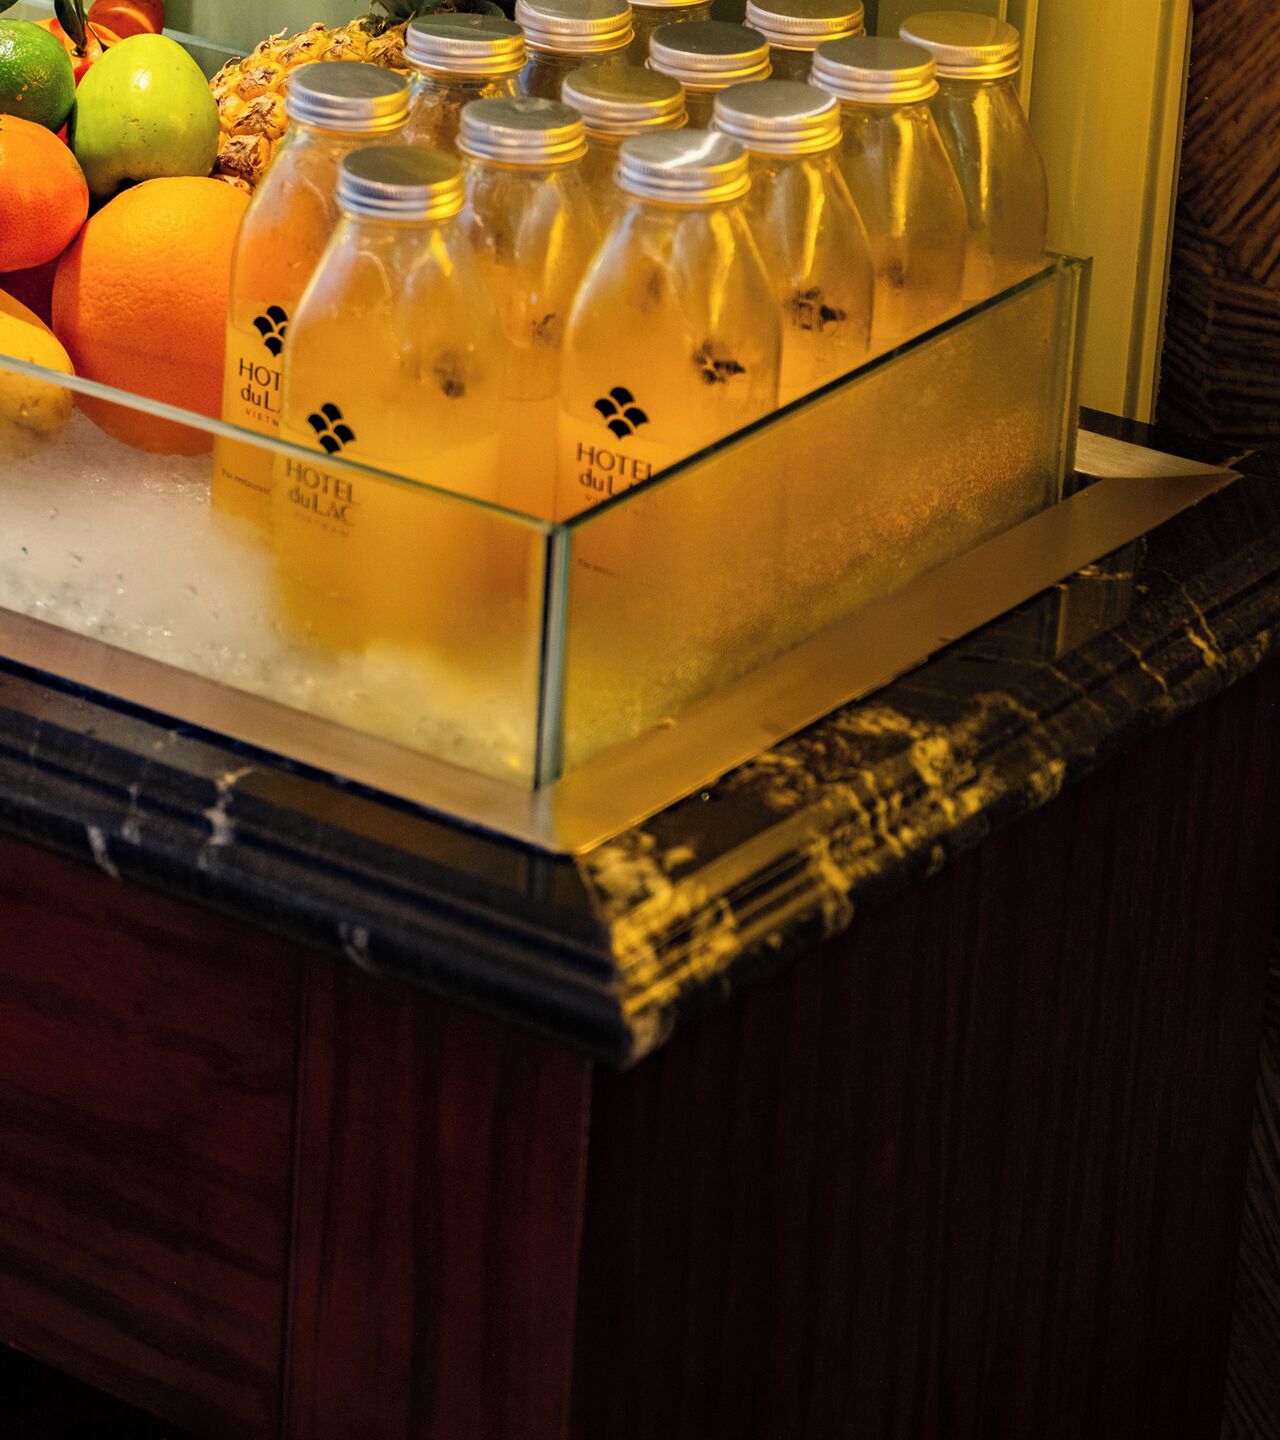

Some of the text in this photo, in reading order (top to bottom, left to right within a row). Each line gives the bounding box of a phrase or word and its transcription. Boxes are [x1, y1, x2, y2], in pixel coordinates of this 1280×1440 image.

[239, 357, 282, 392] HOT
[245, 407, 280, 427] VIETN
[285, 457, 359, 504] HOTEL
[576, 442, 653, 482] HOTEL
